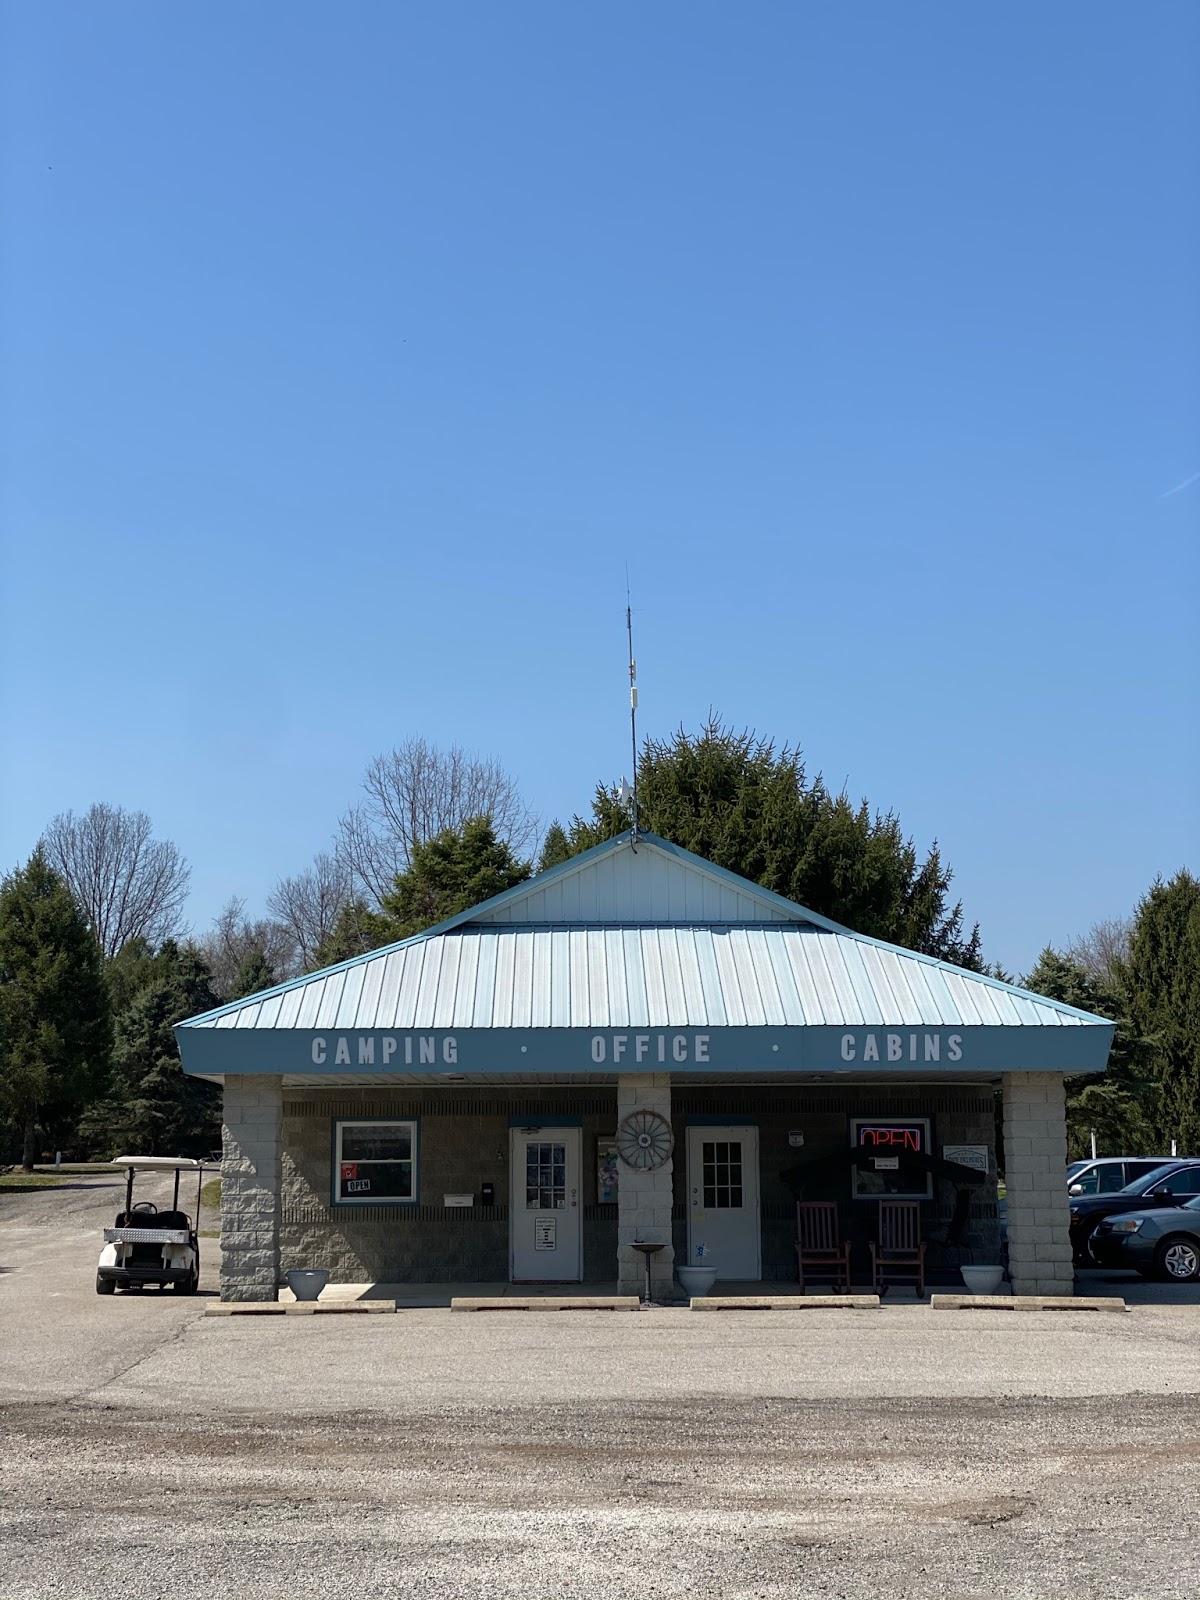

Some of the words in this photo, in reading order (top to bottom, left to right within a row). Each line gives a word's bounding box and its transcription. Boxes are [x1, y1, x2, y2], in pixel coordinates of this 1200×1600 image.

[311, 1036, 458, 1065] CAMPING
[591, 1034, 710, 1063] OFFICE
[841, 1033, 963, 1061] CABINS
[350, 1180, 369, 1191] OPEN
